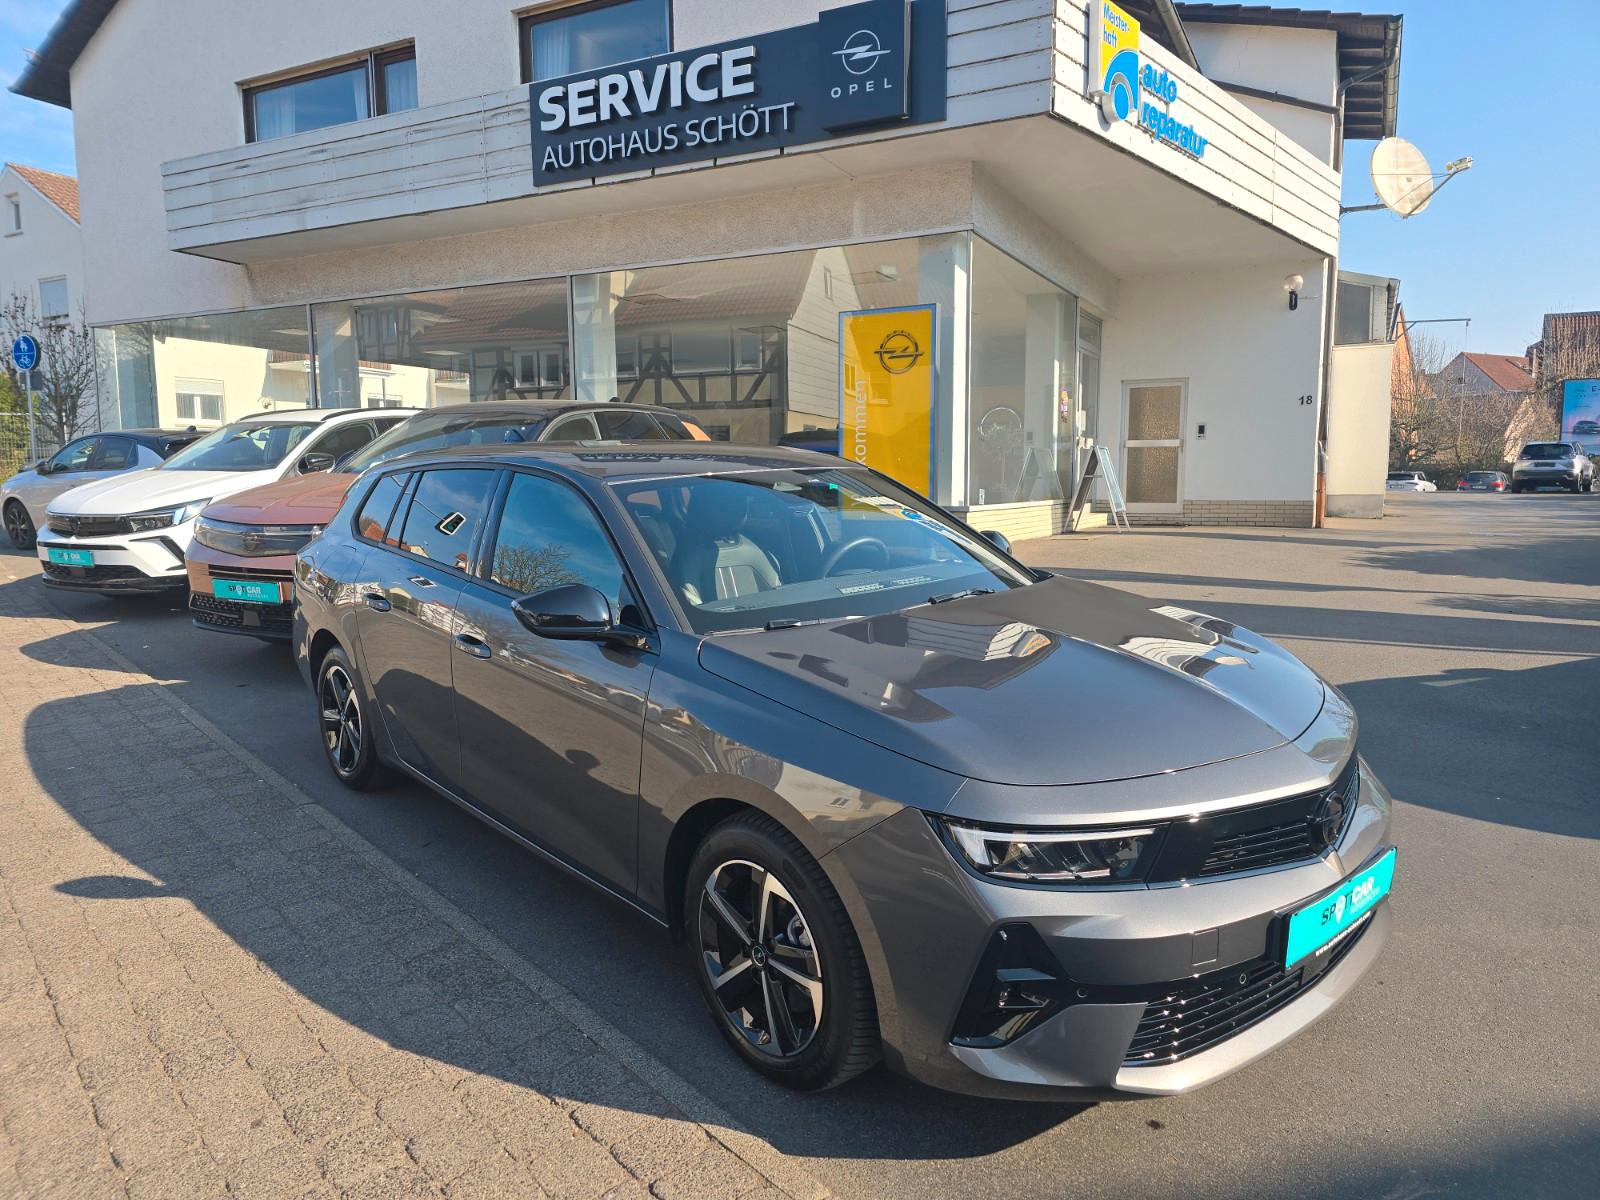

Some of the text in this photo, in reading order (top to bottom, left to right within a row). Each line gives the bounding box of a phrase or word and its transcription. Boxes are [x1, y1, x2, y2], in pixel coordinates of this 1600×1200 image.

[538, 45, 756, 132] SERVICE
[831, 78, 893, 98] OPEL
[1142, 63, 1177, 103] auto
[541, 101, 796, 171] AUTOHAUS SCHÖTT
[1141, 101, 1209, 157] reparatur
[1298, 395, 1313, 406] 18
